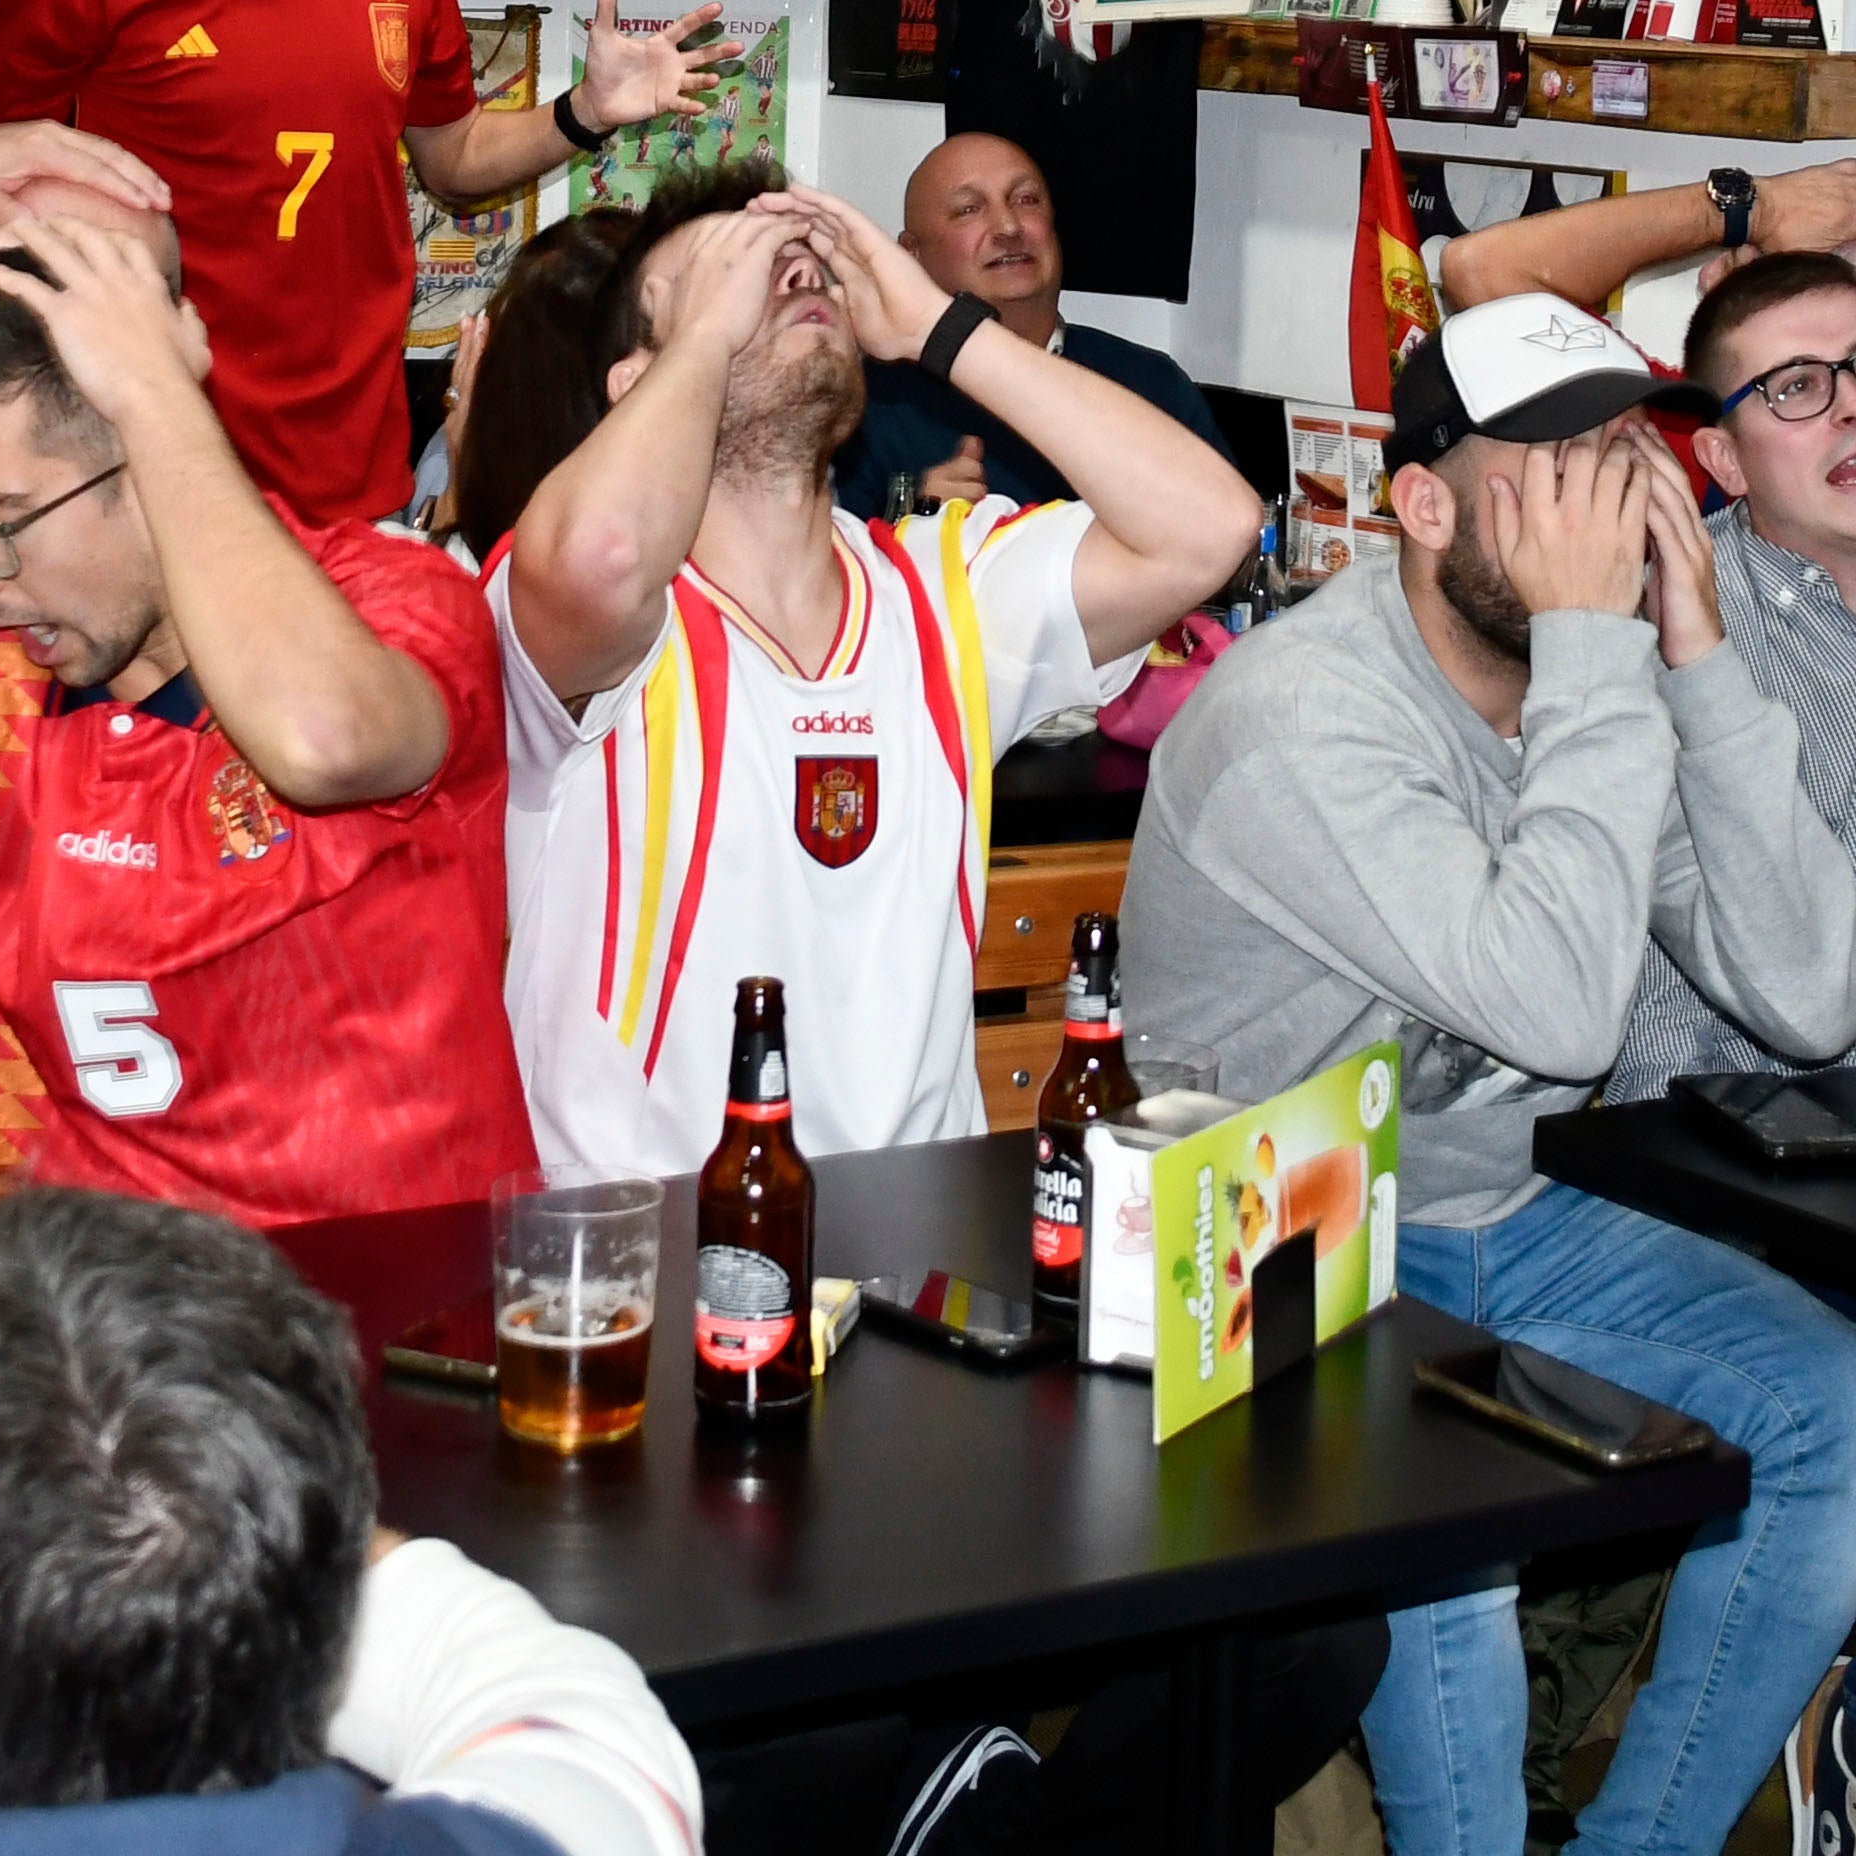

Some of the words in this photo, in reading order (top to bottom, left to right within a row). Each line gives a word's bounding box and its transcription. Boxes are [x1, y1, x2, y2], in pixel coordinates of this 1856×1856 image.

[583, 17, 676, 34] SRTING
[720, 19, 779, 34] YENDA
[276, 130, 335, 241] 7
[791, 709, 874, 736] adidas
[55, 826, 158, 872] adidas
[50, 978, 183, 1119] 5
[1032, 1170, 1083, 1198] rella
[1032, 1196, 1080, 1225] licia
[1192, 1162, 1217, 1383] smoothies
